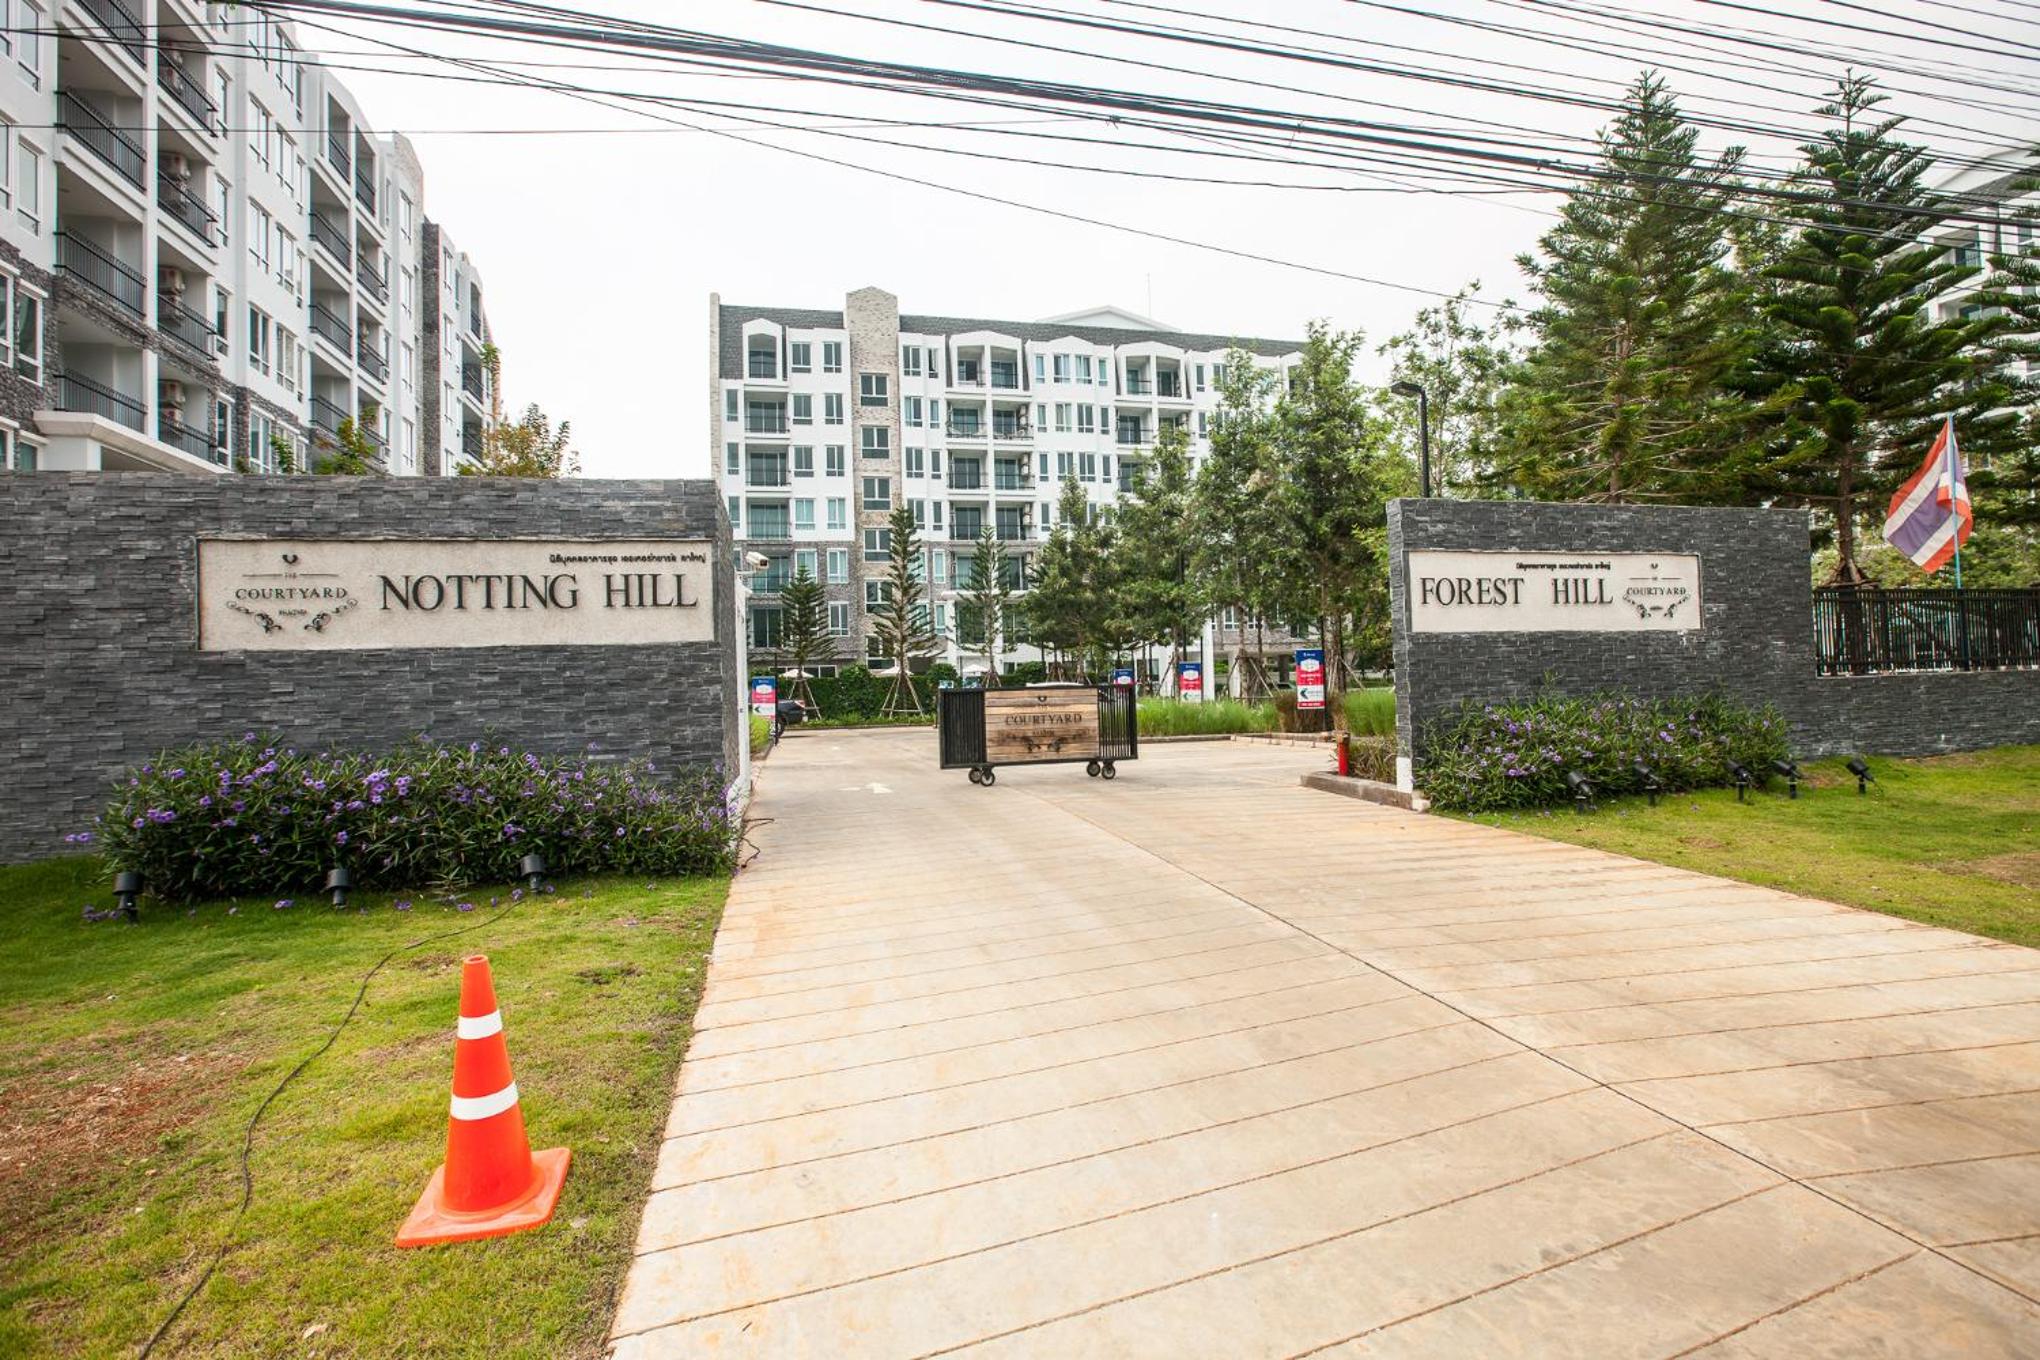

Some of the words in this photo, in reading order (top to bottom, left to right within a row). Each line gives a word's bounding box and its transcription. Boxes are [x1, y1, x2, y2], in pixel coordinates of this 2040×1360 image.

[235, 587, 348, 600] COURTYARD
[379, 574, 579, 611] NOTTING
[603, 573, 699, 608] HILL
[1420, 577, 1525, 606] FOREST
[1551, 578, 1614, 605] HILL
[1626, 586, 1687, 596] COURTYARD
[1005, 713, 1083, 726] COURTYARD
